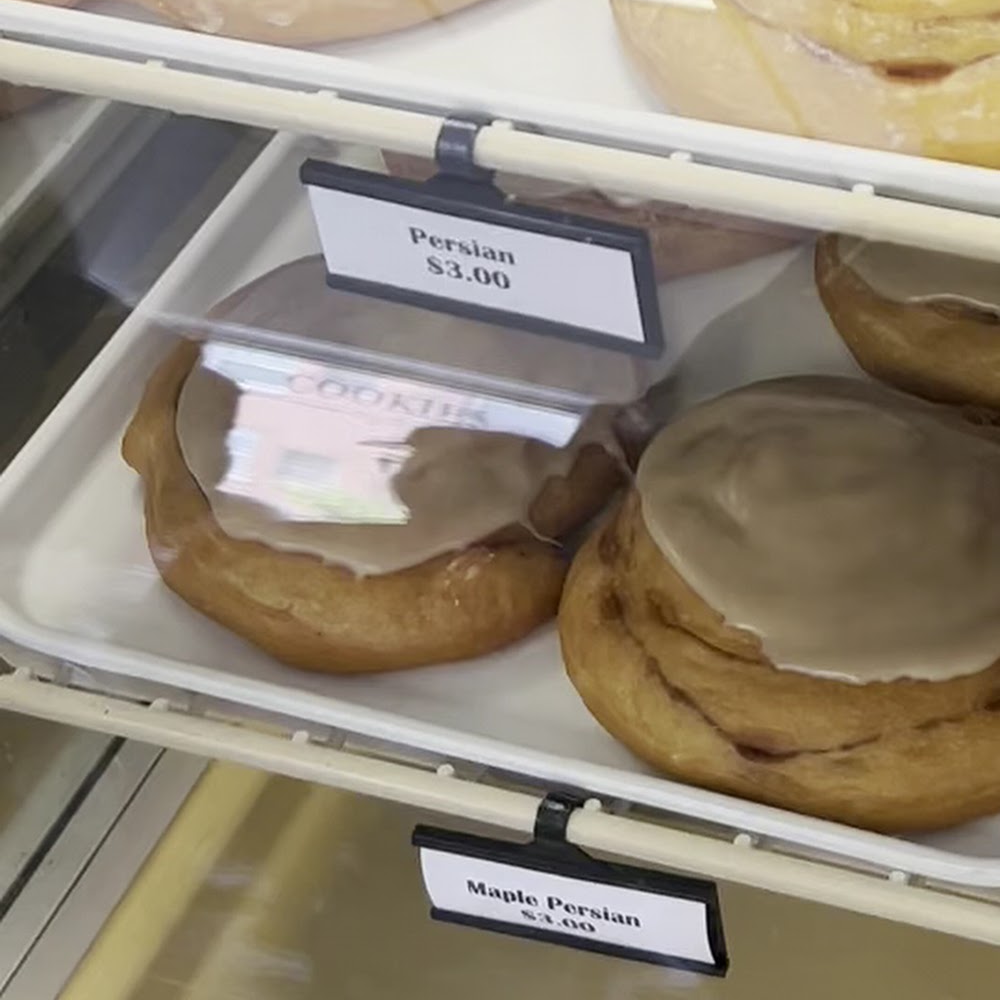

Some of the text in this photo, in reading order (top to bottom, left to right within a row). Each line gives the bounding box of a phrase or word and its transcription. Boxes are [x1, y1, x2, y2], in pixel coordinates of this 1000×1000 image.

[408, 226, 516, 265] Persian
[426, 255, 510, 289] $3.00
[467, 880, 641, 928] Maple Persian
